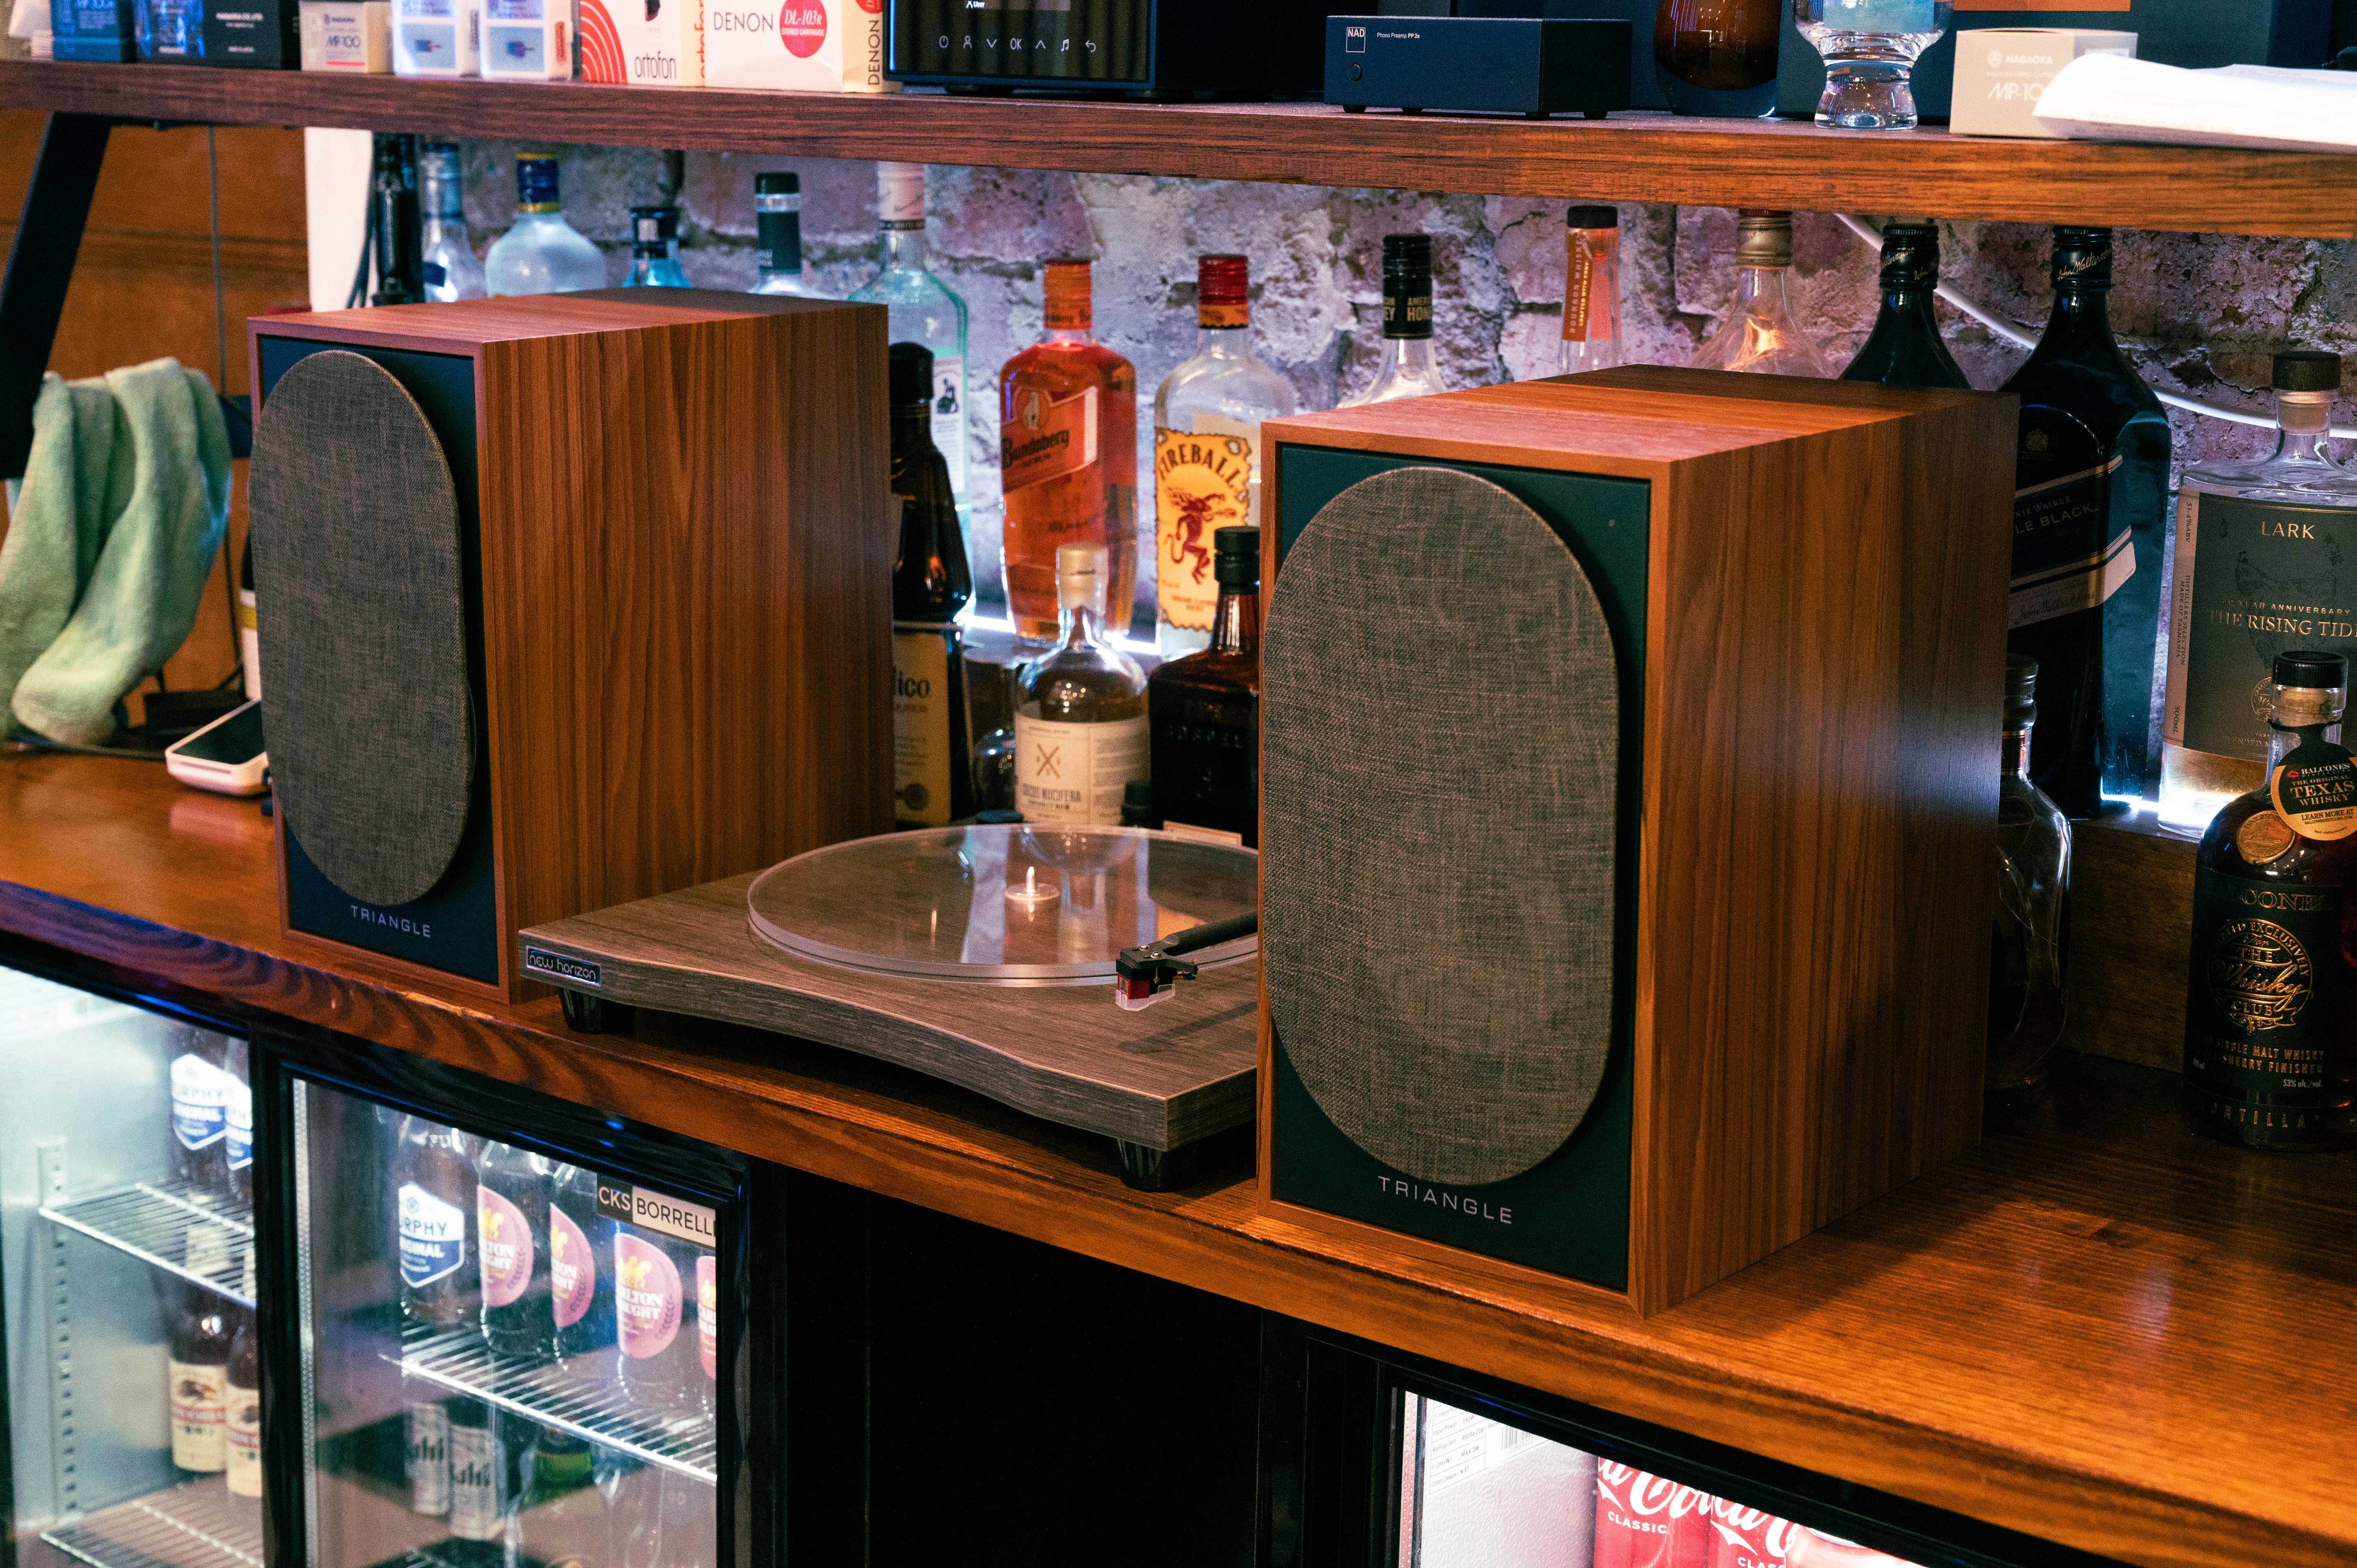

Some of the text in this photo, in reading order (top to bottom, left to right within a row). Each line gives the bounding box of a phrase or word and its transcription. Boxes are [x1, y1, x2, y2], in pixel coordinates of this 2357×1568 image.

[714, 11, 773, 32] DENON
[784, 9, 822, 25] DL-103R
[1348, 28, 1365, 37] NAD
[1010, 38, 1022, 50] OK
[868, 20, 880, 86] DENON
[2005, 54, 2053, 65] NAGAOKA
[635, 50, 677, 79] ortofon
[1569, 284, 1581, 333] BOURBON
[1157, 443, 1243, 489] FIREBALL
[2033, 496, 2071, 512] WALKER
[2039, 502, 2095, 527] BLACK
[2261, 521, 2314, 540] LARK
[2183, 575, 2191, 621] DISTILLERS
[2178, 605, 2183, 615] OF
[2238, 599, 2265, 609] YEAR
[2270, 603, 2351, 616] ANNIVERSARY
[2247, 614, 2312, 635] RISING
[2172, 705, 2180, 735] 500ML
[2301, 763, 2350, 775] BALCONES
[2310, 775, 2350, 784] ORIGINAL
[2289, 780, 2355, 799] TEXAS
[2299, 793, 2349, 806] WHISKY
[2301, 813, 2324, 821] LEARN
[2325, 810, 2345, 818] MORE
[350, 905, 430, 938] TRIANGLE
[2243, 933, 2270, 946] For
[2238, 946, 2273, 962] THE
[2249, 921, 2310, 978] EXCLUSIVELY
[529, 954, 597, 980] new horizon
[2211, 963, 2305, 1014] Whisky
[2231, 999, 2273, 1016] CLUB
[2252, 1045, 2279, 1059] MALT
[2284, 1048, 2324, 1061] WHISKY
[2222, 1054, 2323, 1075] SHERRY FINISHED
[2282, 1079, 2296, 1088] 53%
[598, 1186, 631, 1211] CKS
[1378, 1176, 1512, 1224] TRIANGLE
[400, 1217, 447, 1236] RPHY
[1462, 1414, 1475, 1424] 190W
[1488, 1421, 1500, 1429] Seria
[1433, 1427, 1444, 1436] Input
[1461, 1426, 1485, 1441] R600a(23g)
[1461, 1445, 1480, 1457] MAX 3W
[1608, 1511, 1667, 1535] CLASSIC
